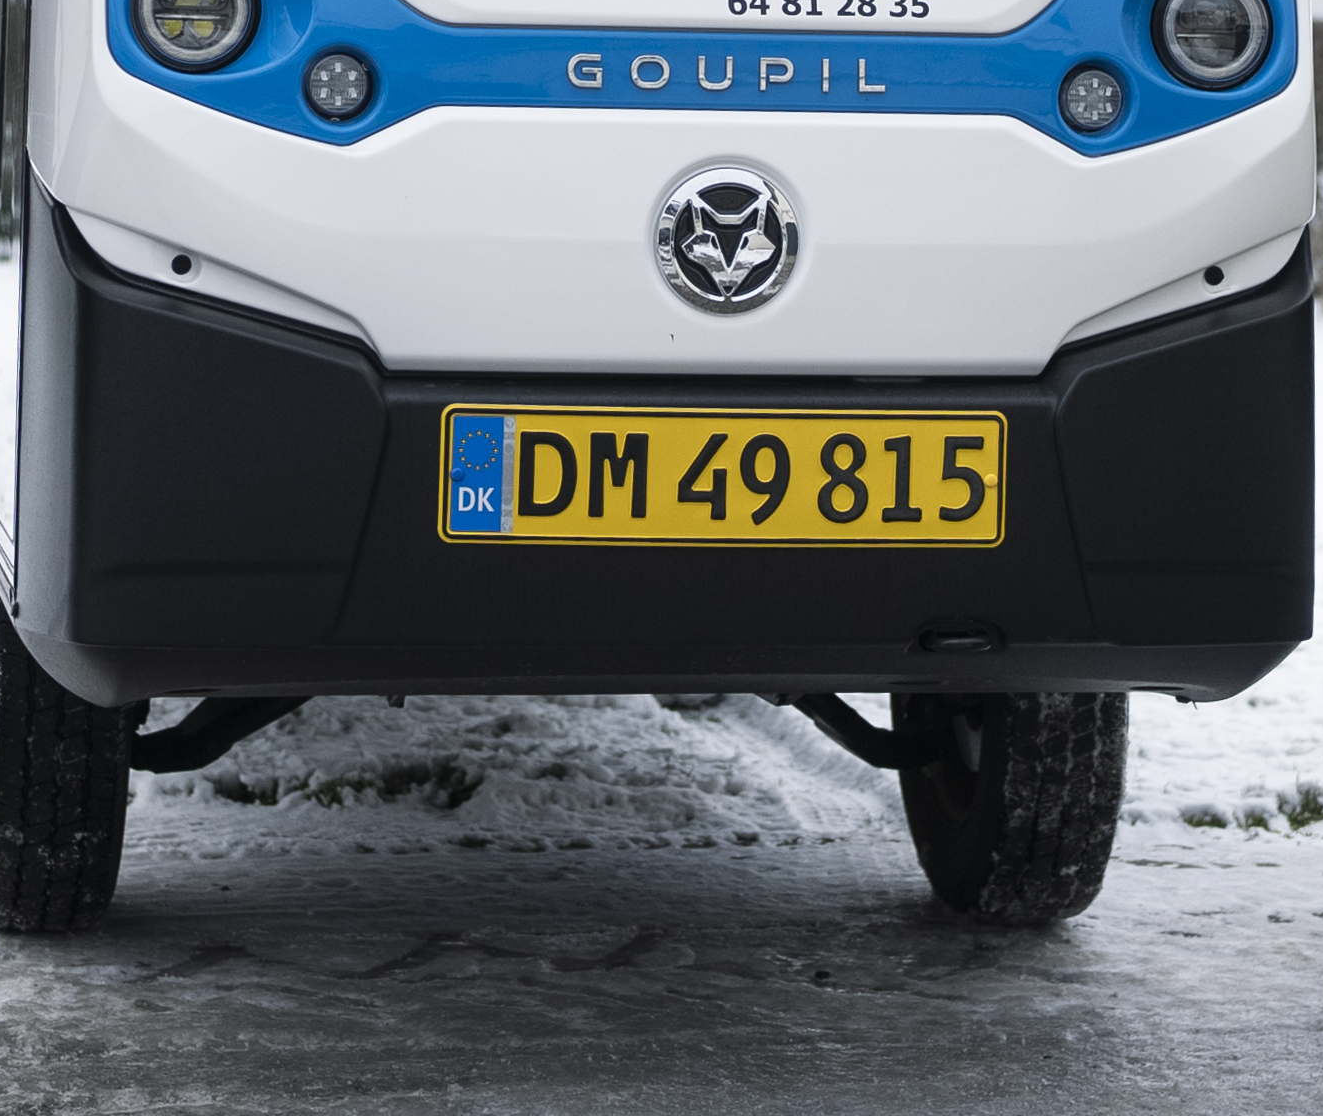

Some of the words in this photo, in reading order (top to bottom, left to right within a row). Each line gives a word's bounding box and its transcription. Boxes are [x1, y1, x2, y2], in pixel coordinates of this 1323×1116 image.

[566, 52, 887, 93] GOUPIL
[517, 430, 649, 520] DM
[677, 432, 791, 526] 49
[816, 432, 986, 525] 815
[457, 486, 495, 513] DK
